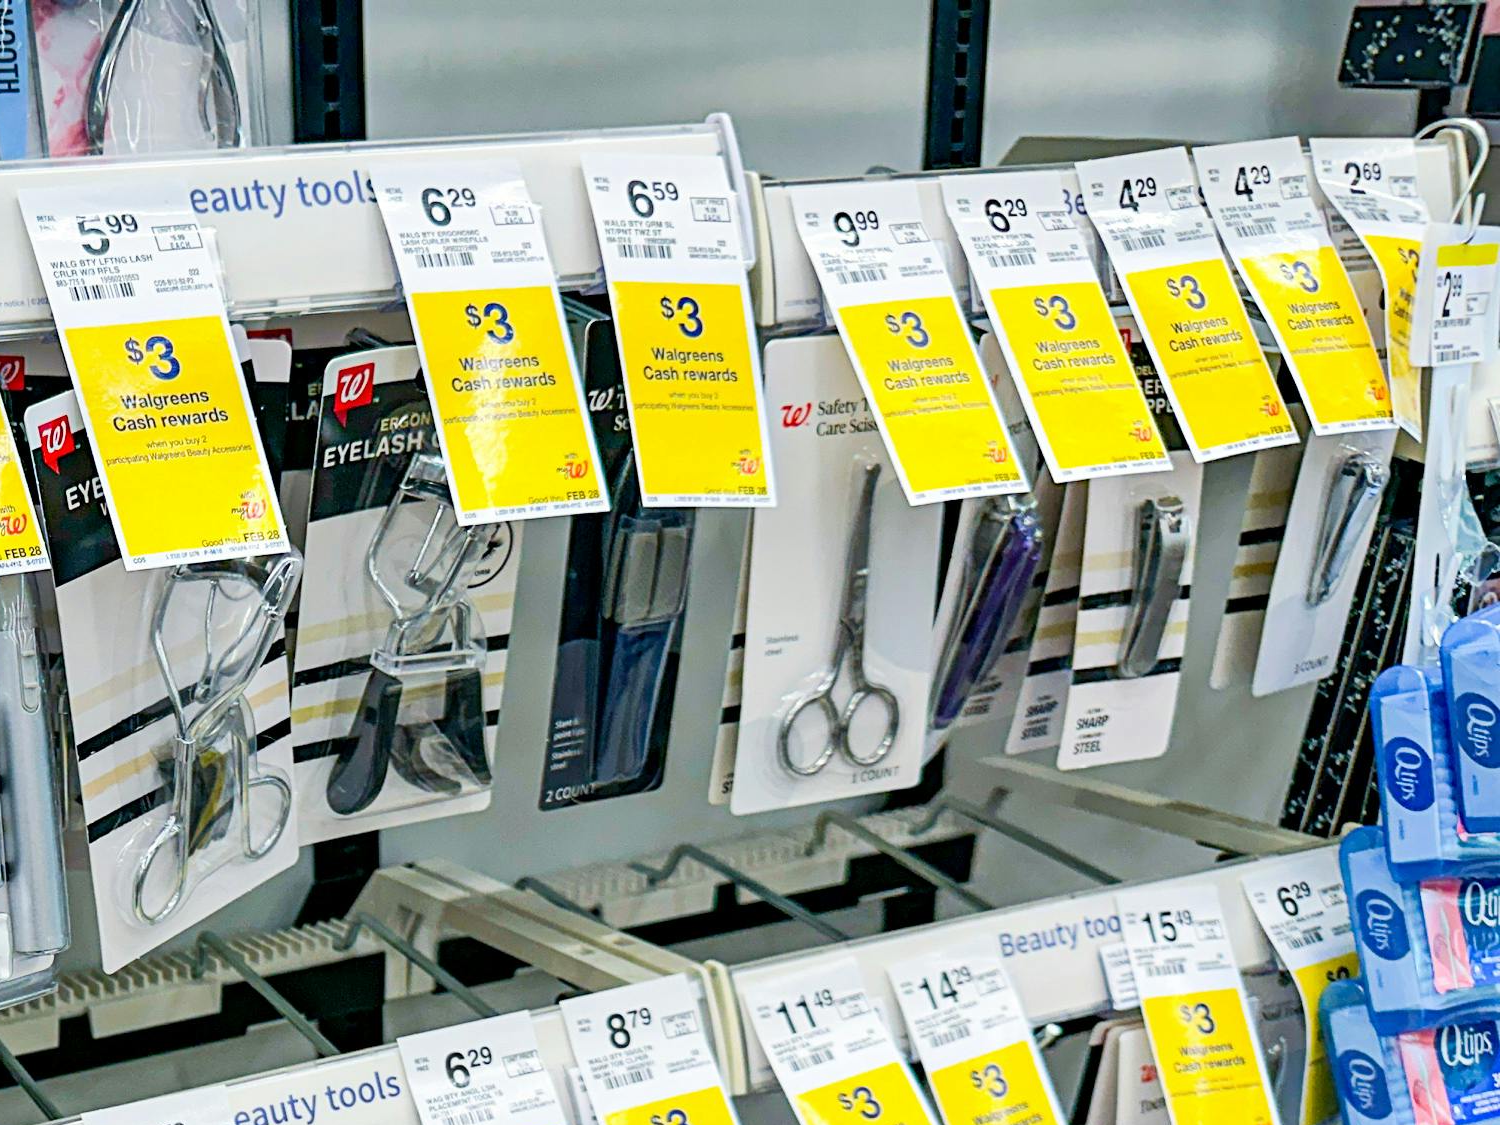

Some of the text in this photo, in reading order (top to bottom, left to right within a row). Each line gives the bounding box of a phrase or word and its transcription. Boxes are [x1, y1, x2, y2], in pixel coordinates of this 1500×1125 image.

[125, 335, 182, 381] $3
[651, 348, 725, 364] Walgreens
[643, 366, 739, 383] Cash rewards
[121, 389, 210, 411] Walgreens
[816, 398, 859, 417] Safety
[112, 405, 230, 433] Cash rewards
[816, 420, 847, 437] Care
[323, 435, 424, 469] EYELASH
[1000, 926, 1079, 958] Beauty
[324, 1071, 402, 1110] tools
